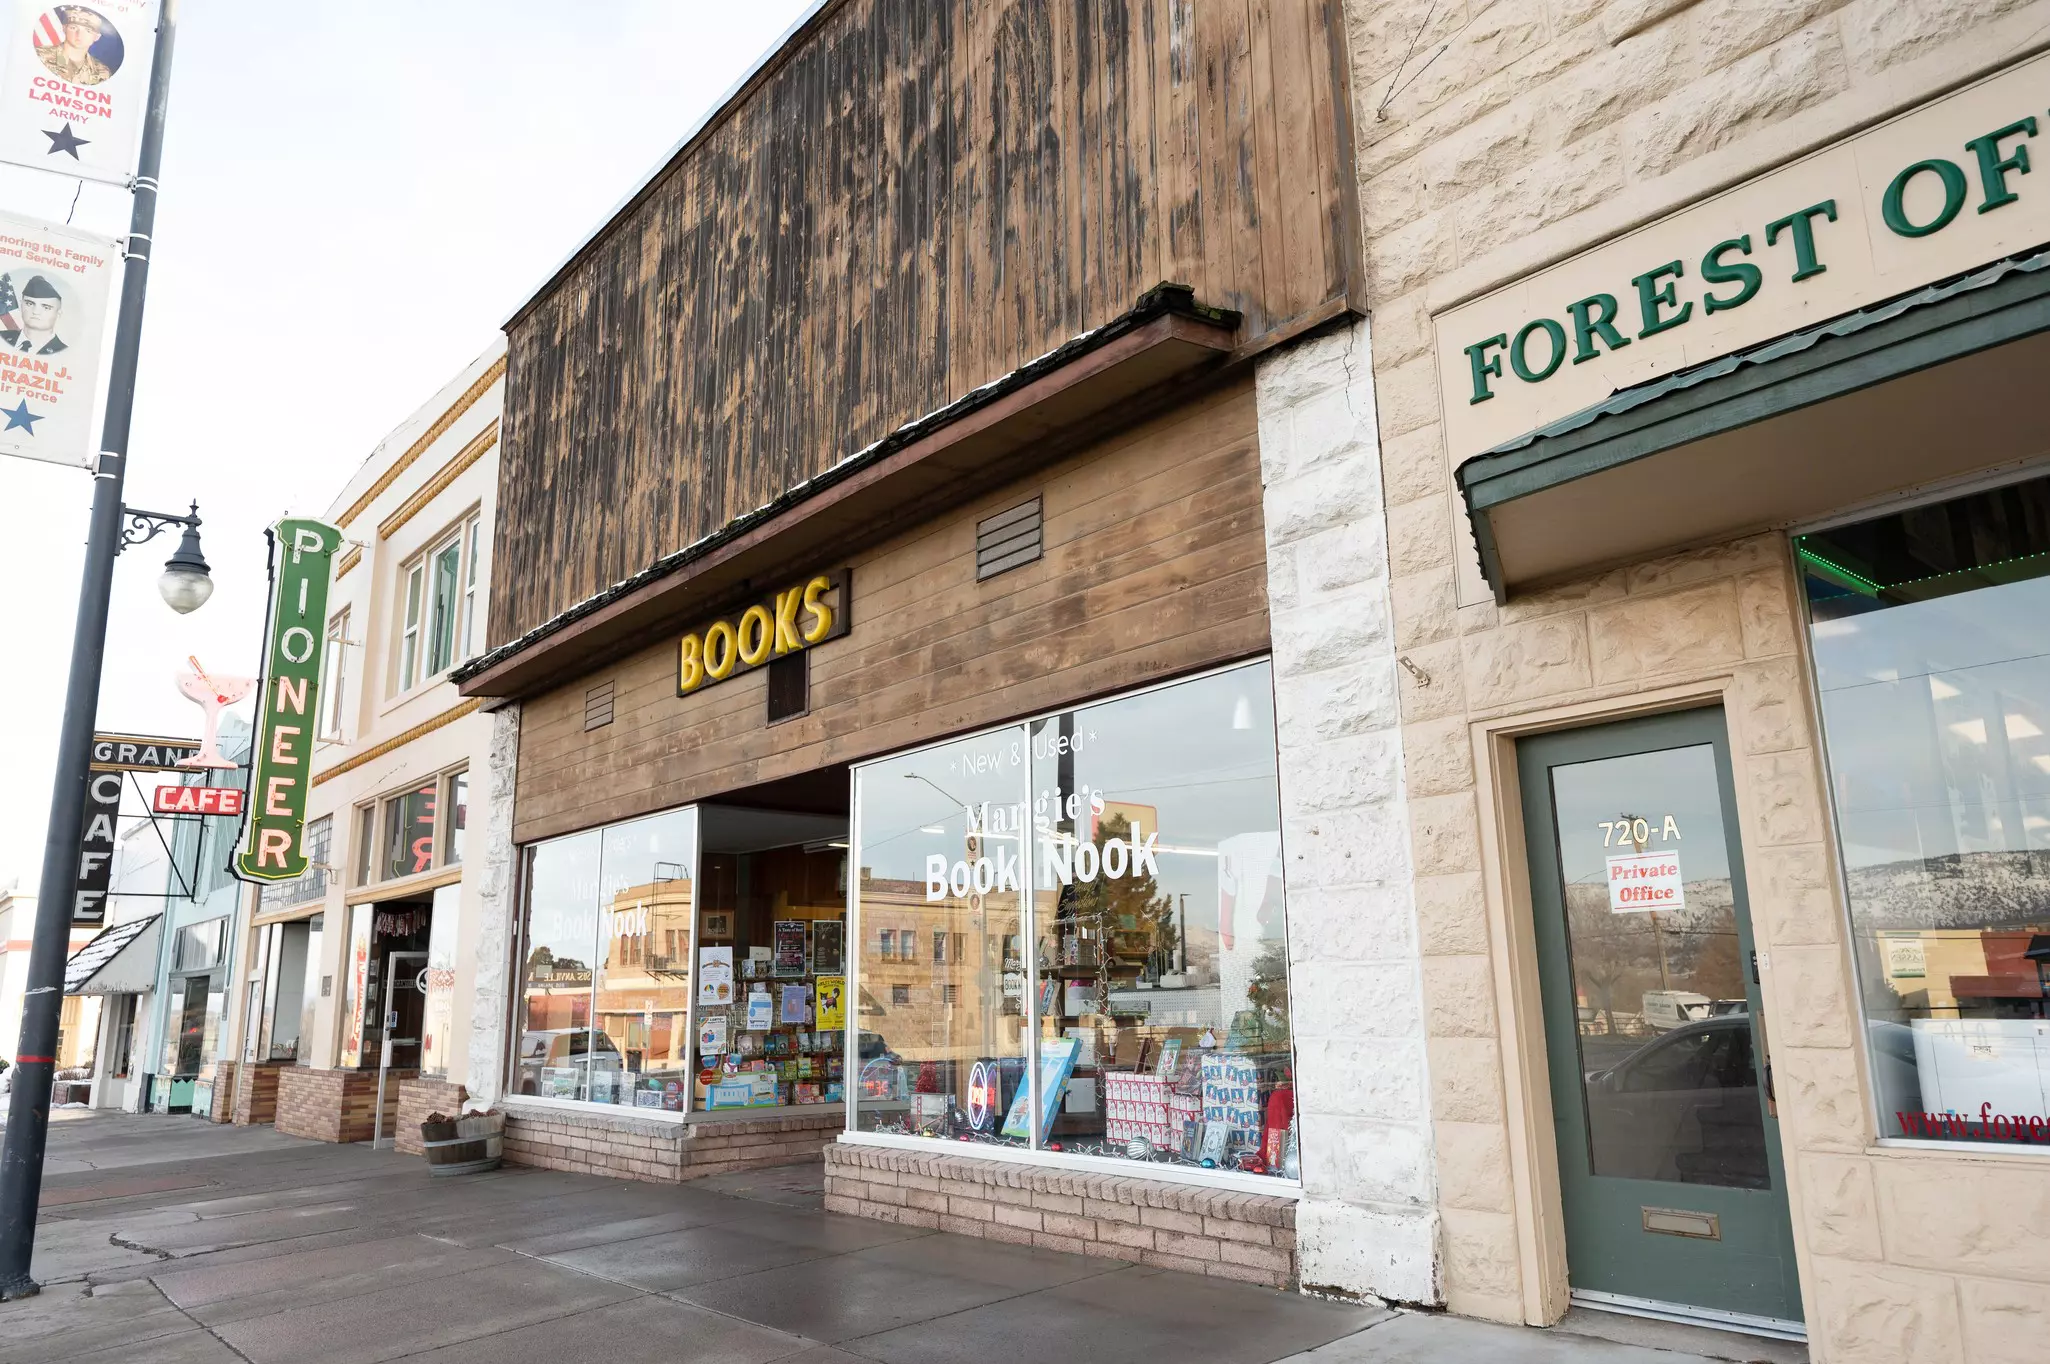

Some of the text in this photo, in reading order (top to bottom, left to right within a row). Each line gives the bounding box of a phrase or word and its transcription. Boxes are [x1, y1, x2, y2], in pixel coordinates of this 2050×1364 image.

[28, 88, 112, 119] LAWSON
[32, 76, 112, 105] COLTON
[49, 108, 89, 124] ARMY
[0, 247, 86, 273] and Service of
[43, 243, 62, 256] the
[64, 248, 104, 267] Family
[1462, 109, 2050, 405] FOREST OF
[0, 352, 72, 380] RIAN J.
[1, 369, 64, 394] RAZIL
[16, 386, 58, 403] Force
[681, 575, 832, 691] BOOKS
[257, 528, 325, 869] PIONEER
[962, 725, 1084, 777] New & Used
[158, 787, 239, 813] CAFE
[965, 783, 1106, 835] Margie's
[1597, 814, 1682, 848] 720-A
[74, 774, 121, 920] CAFE
[926, 844, 1019, 902] Book
[1043, 820, 1160, 888] Nook
[1611, 863, 1678, 881] Private
[1619, 885, 1674, 902] Office
[601, 900, 649, 939] Nook
